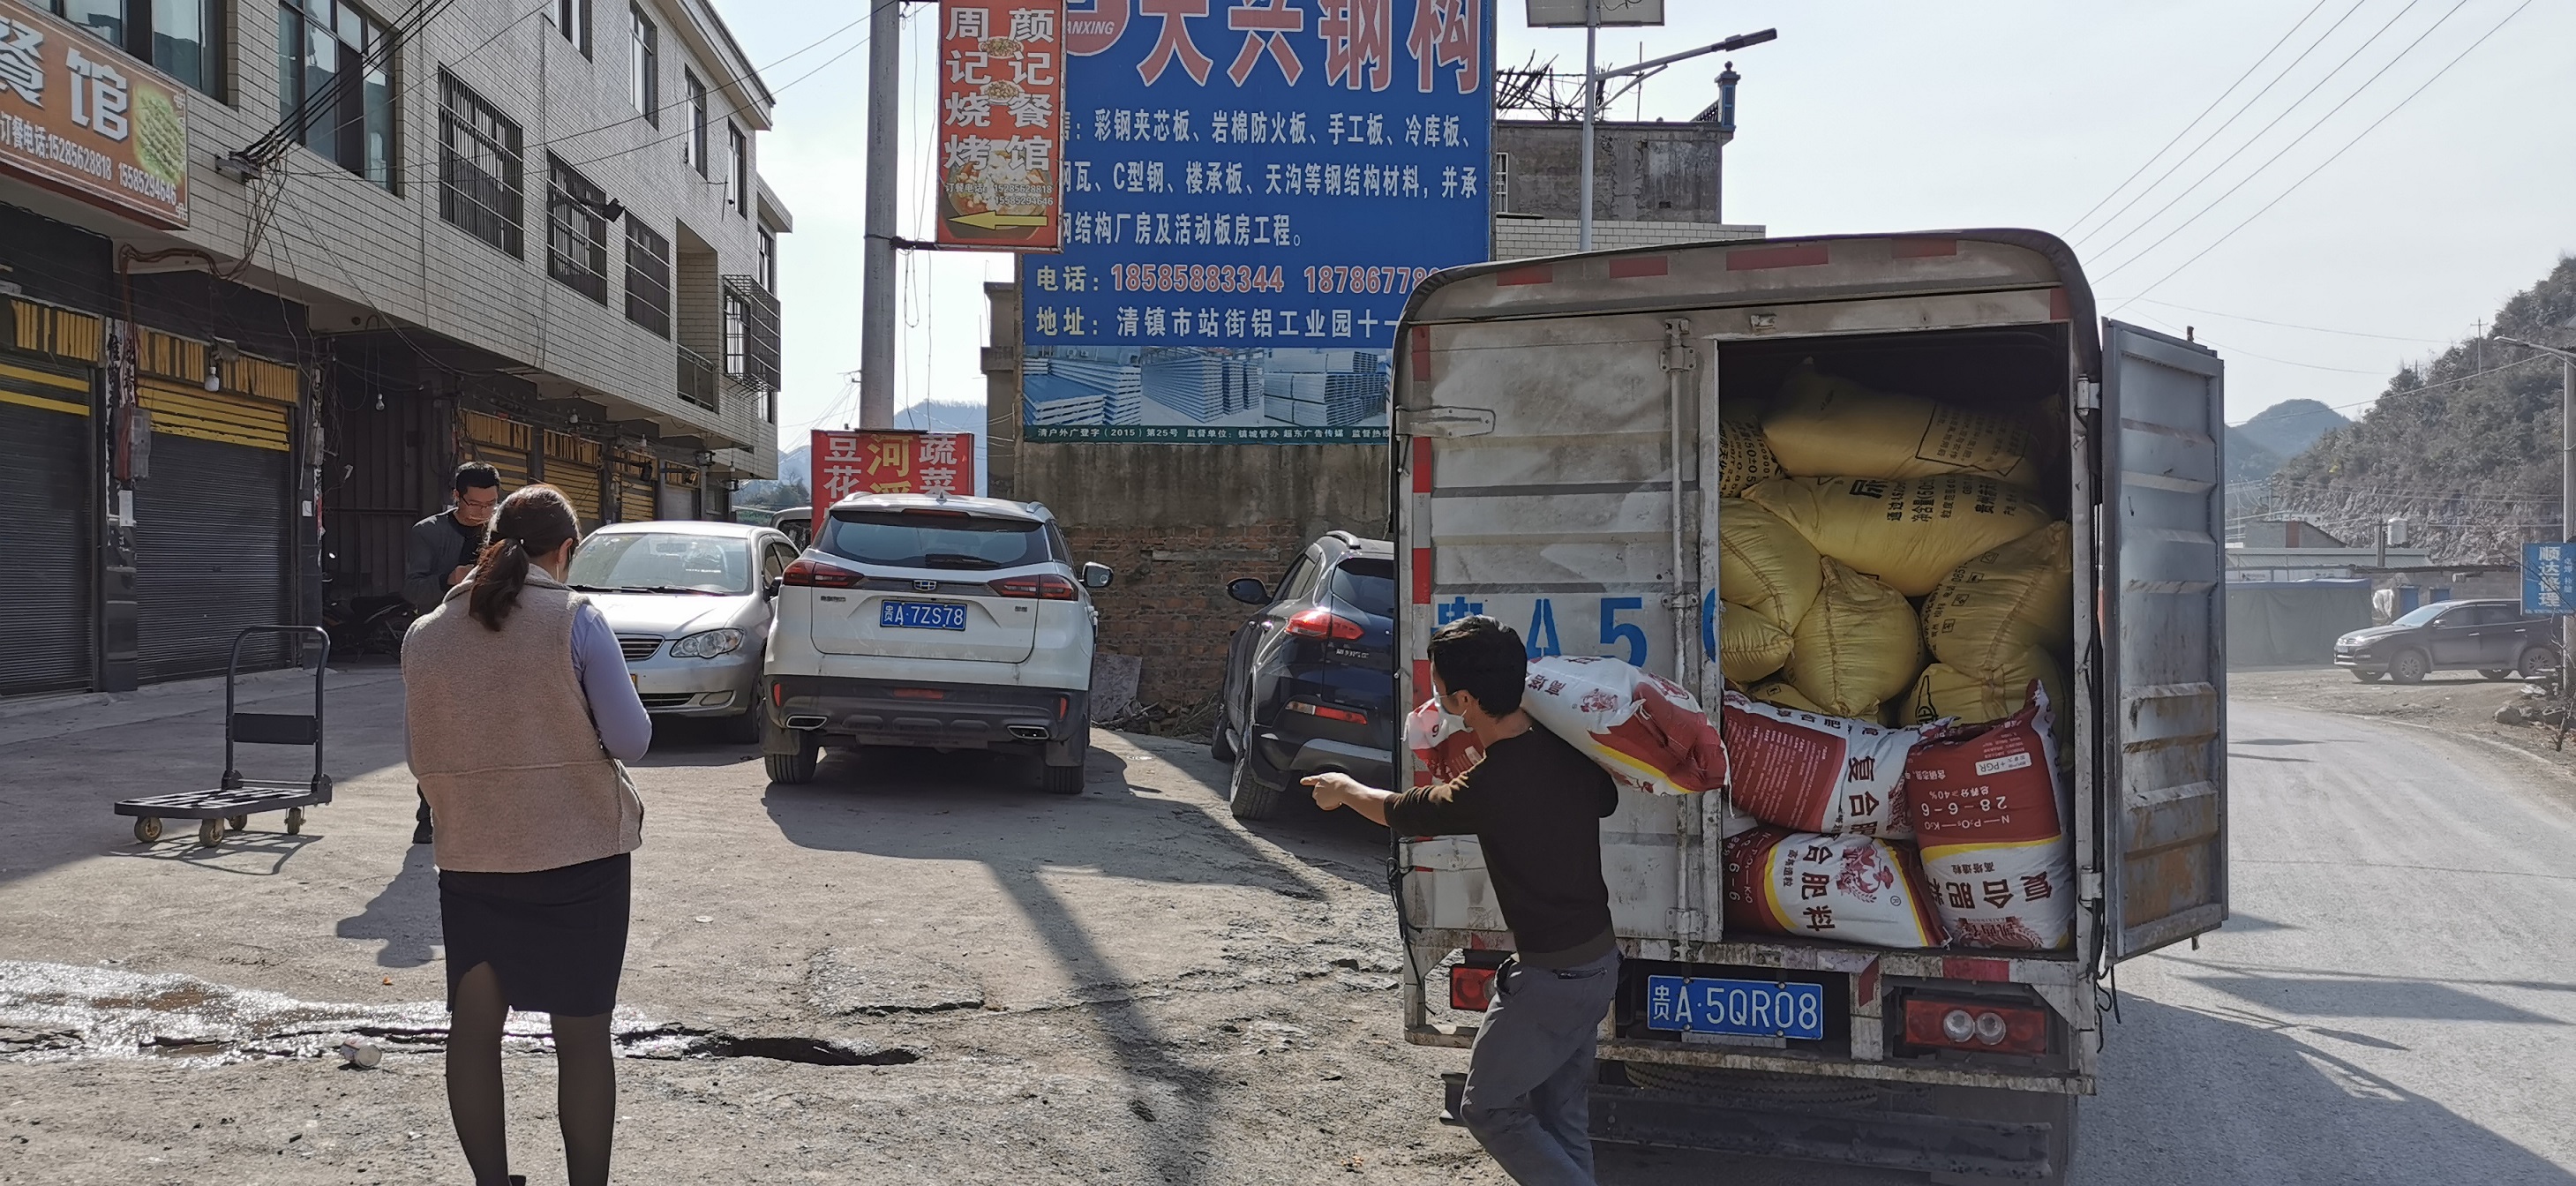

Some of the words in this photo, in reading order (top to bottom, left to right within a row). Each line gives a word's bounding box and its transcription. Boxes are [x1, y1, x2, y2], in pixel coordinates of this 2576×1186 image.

[943, 7, 992, 171] 周记烧烤
[1005, 7, 1055, 172] 颜记餐馆
[117, 161, 176, 206] 15585294646
[994, 184, 1053, 194] 15285628818
[995, 196, 1054, 206] 15585294646
[1110, 263, 1284, 294] 18585883344
[1303, 266, 1440, 295] 18786778
[1801, 834, 1836, 932] 合肥料
